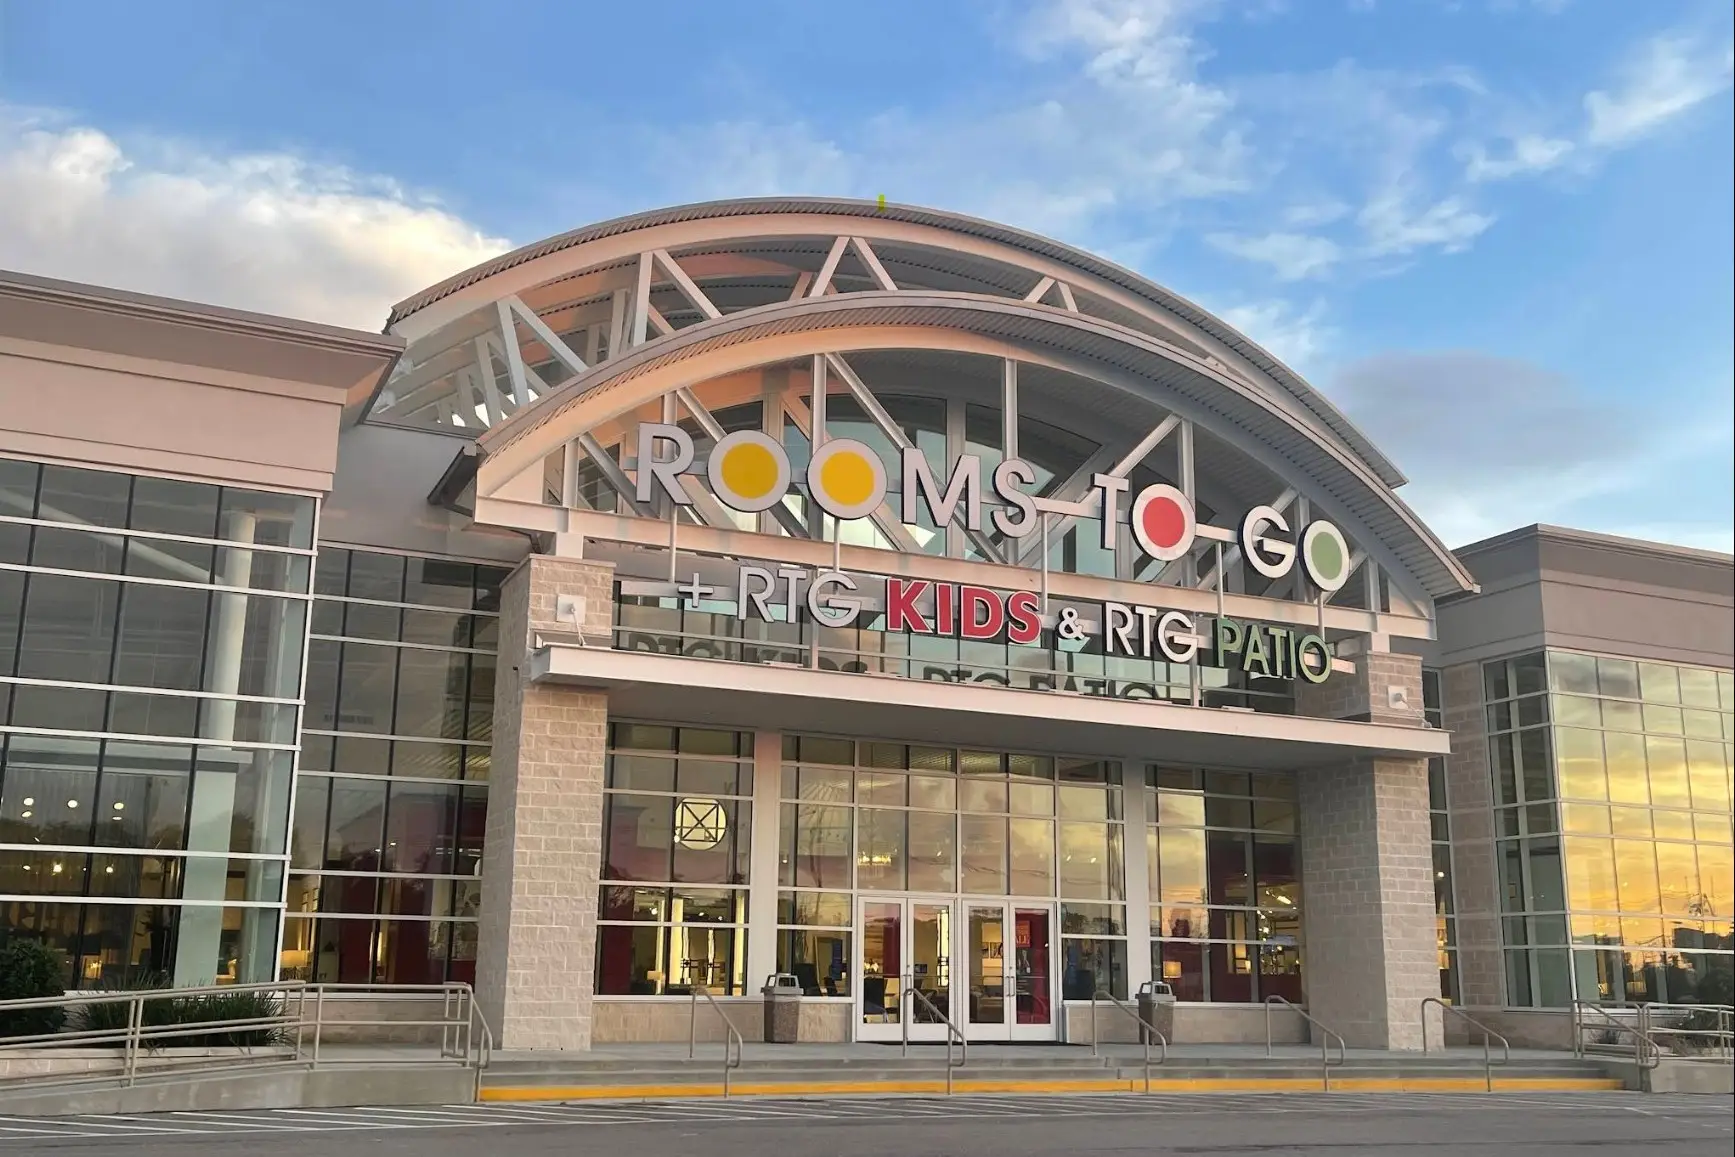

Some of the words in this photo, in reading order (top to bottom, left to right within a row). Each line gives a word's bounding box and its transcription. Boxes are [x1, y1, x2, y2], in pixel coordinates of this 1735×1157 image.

[635, 422, 1038, 538] ROOMS
[1091, 472, 1196, 561] TO
[1238, 505, 1350, 592] GO
[738, 566, 862, 628] RTG
[886, 578, 1042, 644] KIDS
[1057, 606, 1086, 641] &
[1104, 601, 1198, 663] RTG
[1215, 618, 1333, 684] PATIO
